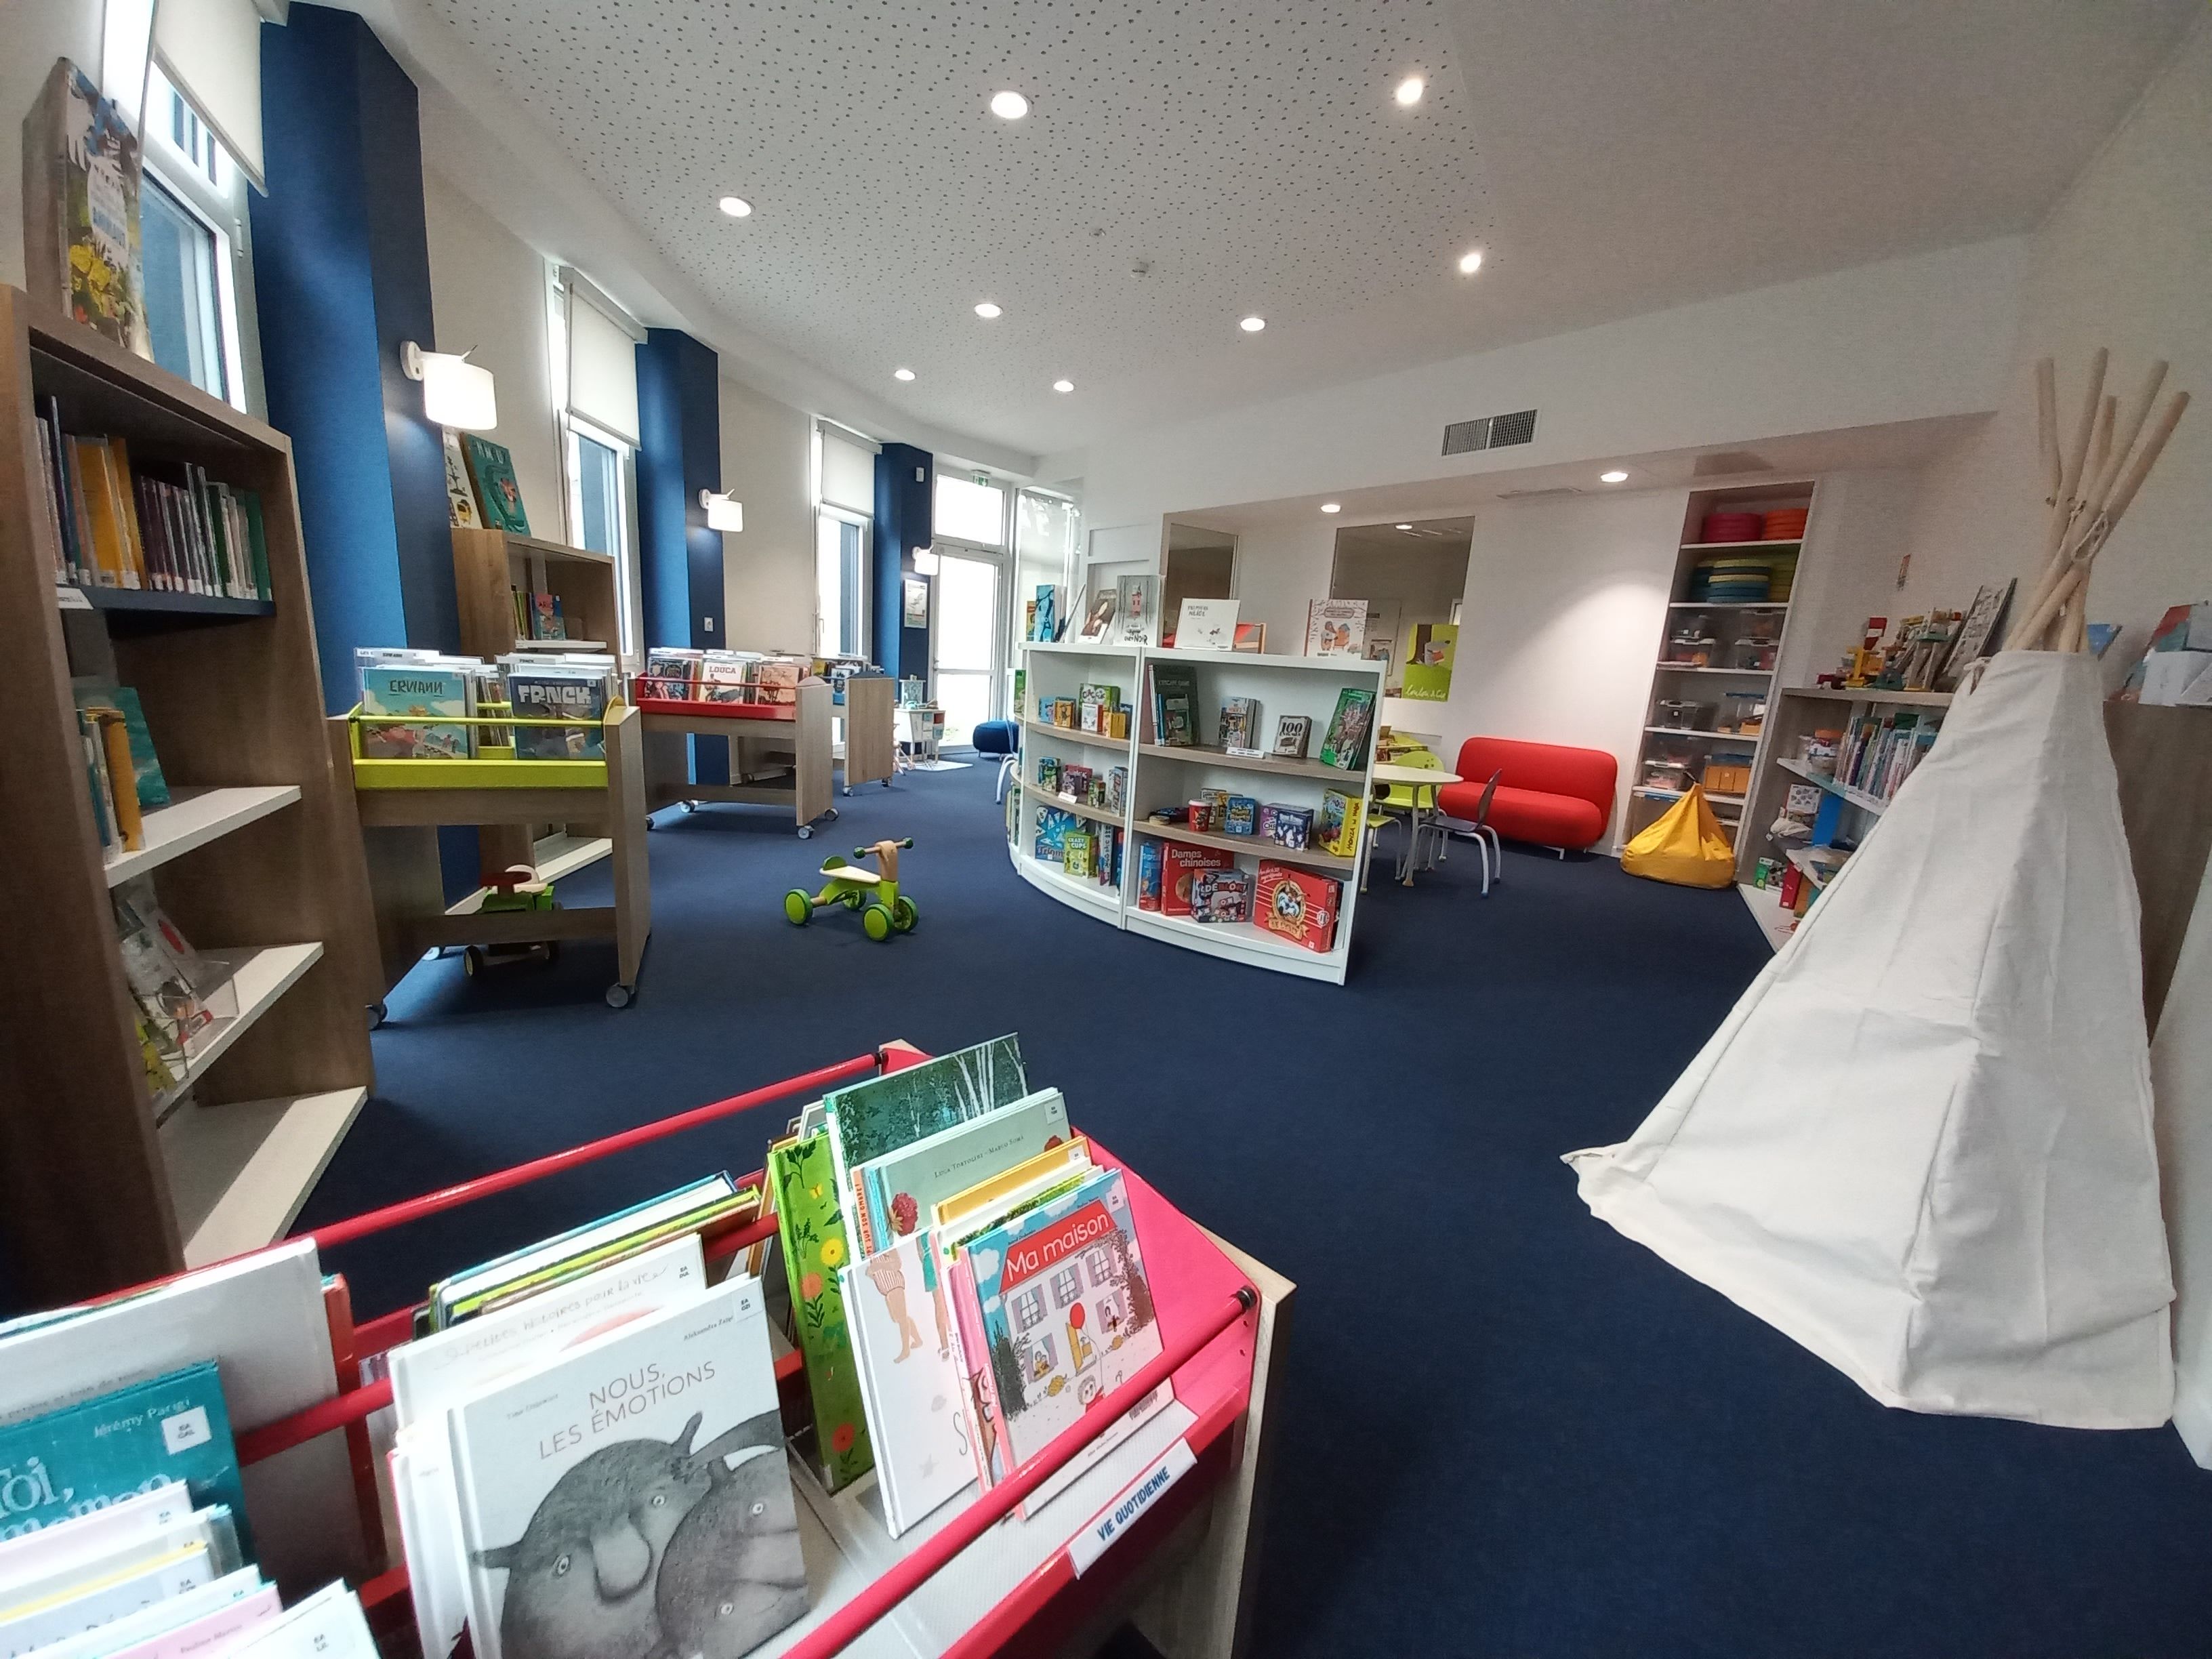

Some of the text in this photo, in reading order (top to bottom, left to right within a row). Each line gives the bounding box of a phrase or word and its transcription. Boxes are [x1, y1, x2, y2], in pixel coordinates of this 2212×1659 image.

[709, 665, 737, 674] LOUCA
[518, 684, 592, 705] FRNCK
[1280, 722, 1303, 733] 100
[1171, 848, 1202, 859] Dames
[1179, 858, 1221, 867] chinoises
[1006, 1213, 1109, 1282] Ma maison
[589, 1363, 665, 1410] NOUS,
[539, 1361, 716, 1460] LES ÉMOTIONS
[1097, 1466, 1171, 1542] VIE QUOTIDIENNE
